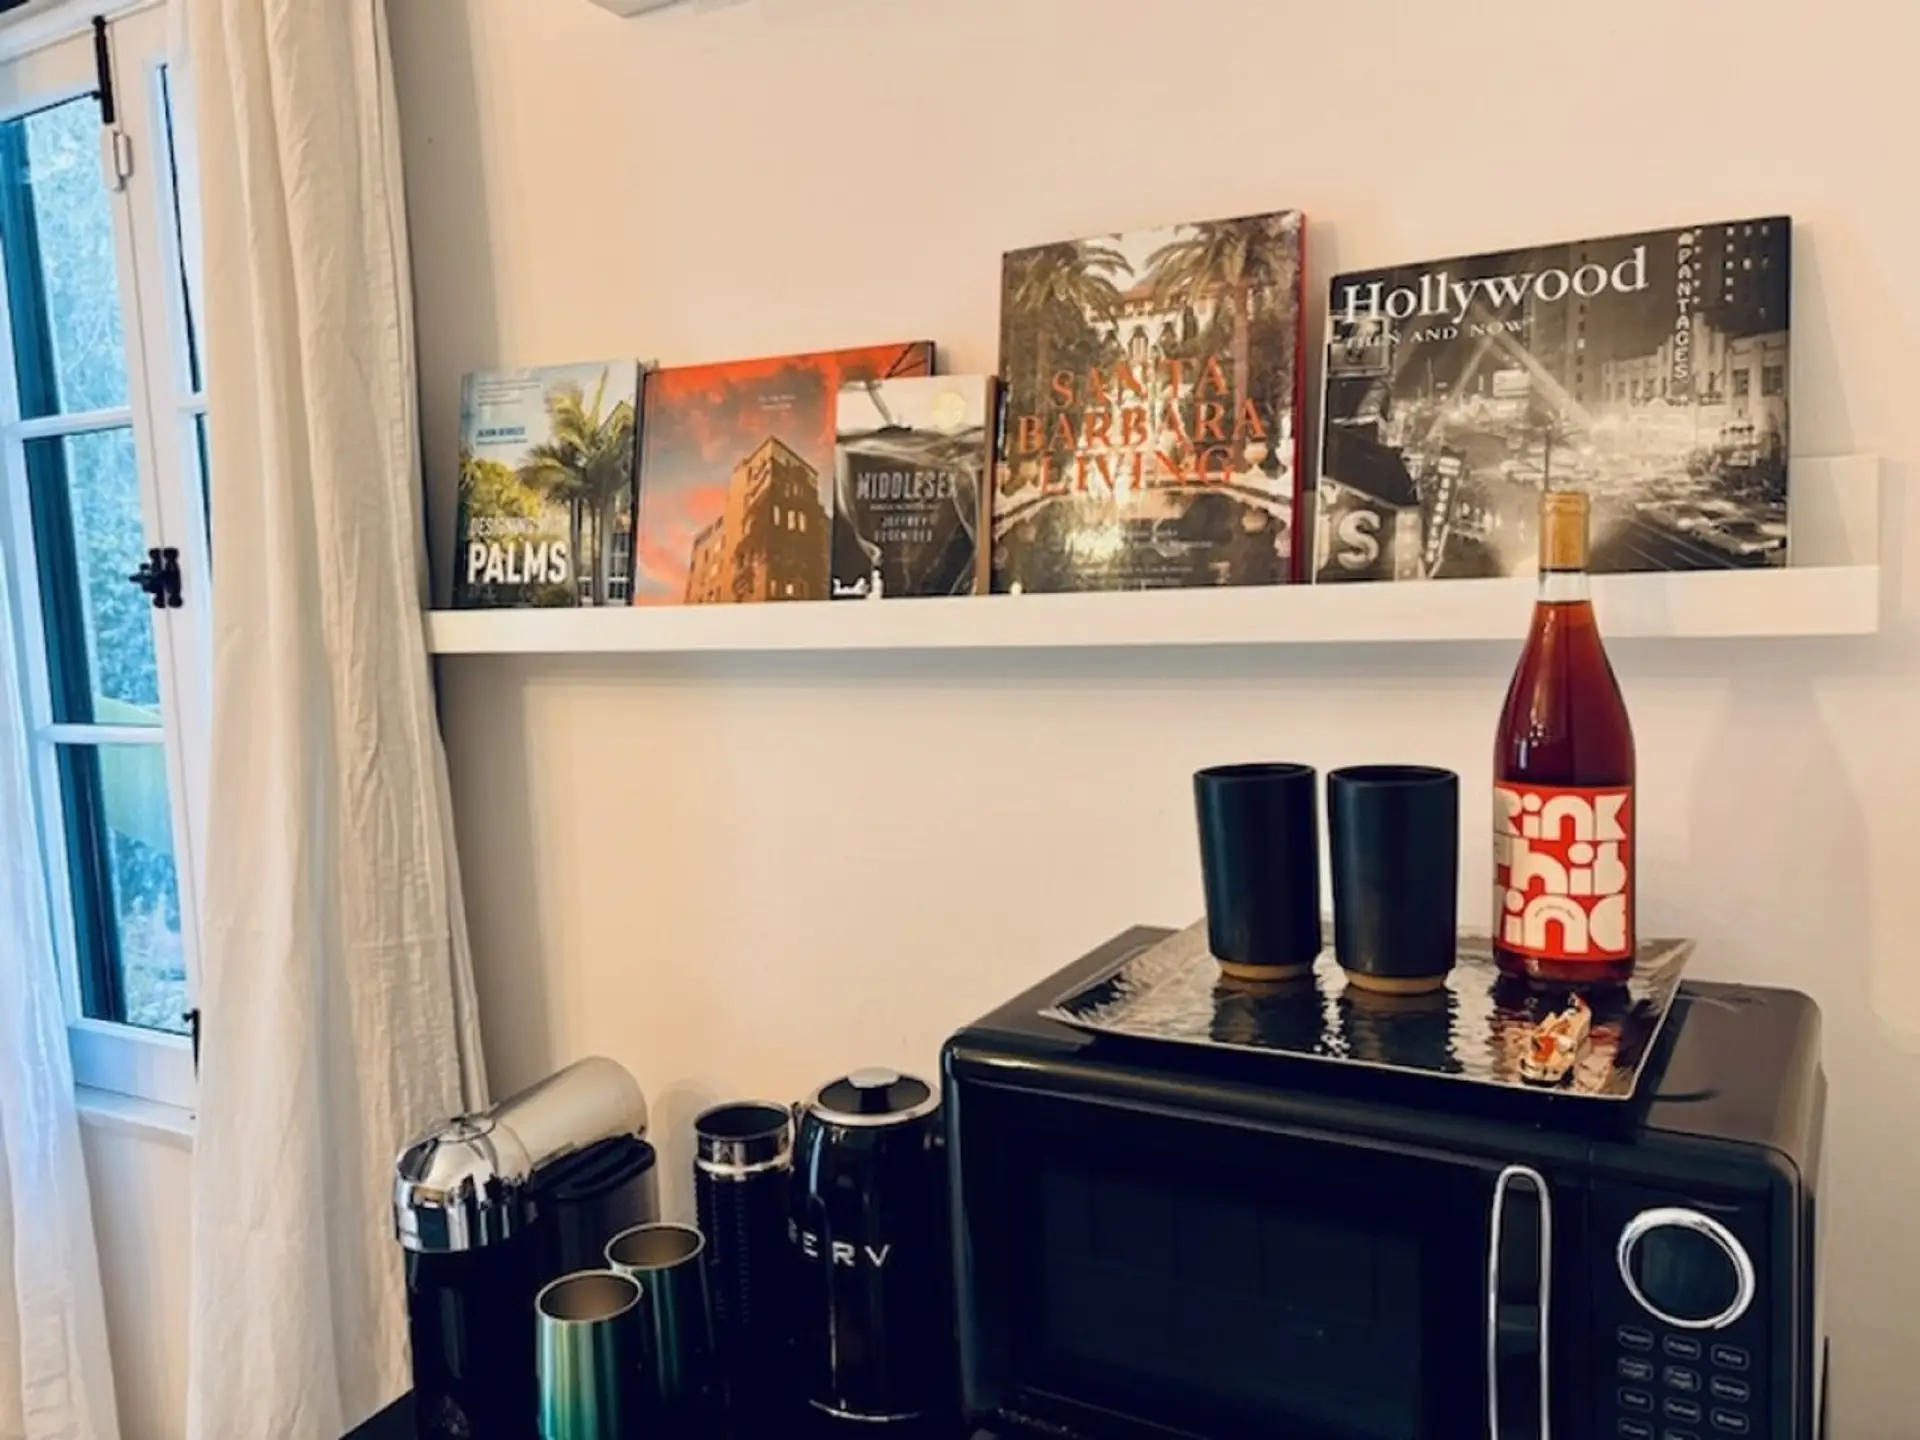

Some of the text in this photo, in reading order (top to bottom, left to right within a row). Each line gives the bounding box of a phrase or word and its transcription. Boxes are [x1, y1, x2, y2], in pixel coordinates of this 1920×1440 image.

[1343, 246, 1648, 324] Hollywood
[1410, 326, 1457, 343] AND
[1674, 248, 1693, 378] PANTAGES
[1051, 356, 1228, 407] SANTA
[1018, 397, 1267, 453] BARBARA
[856, 471, 958, 499] MIDDLESEX
[1039, 445, 1235, 494] LIVING
[467, 541, 567, 584] PALMS
